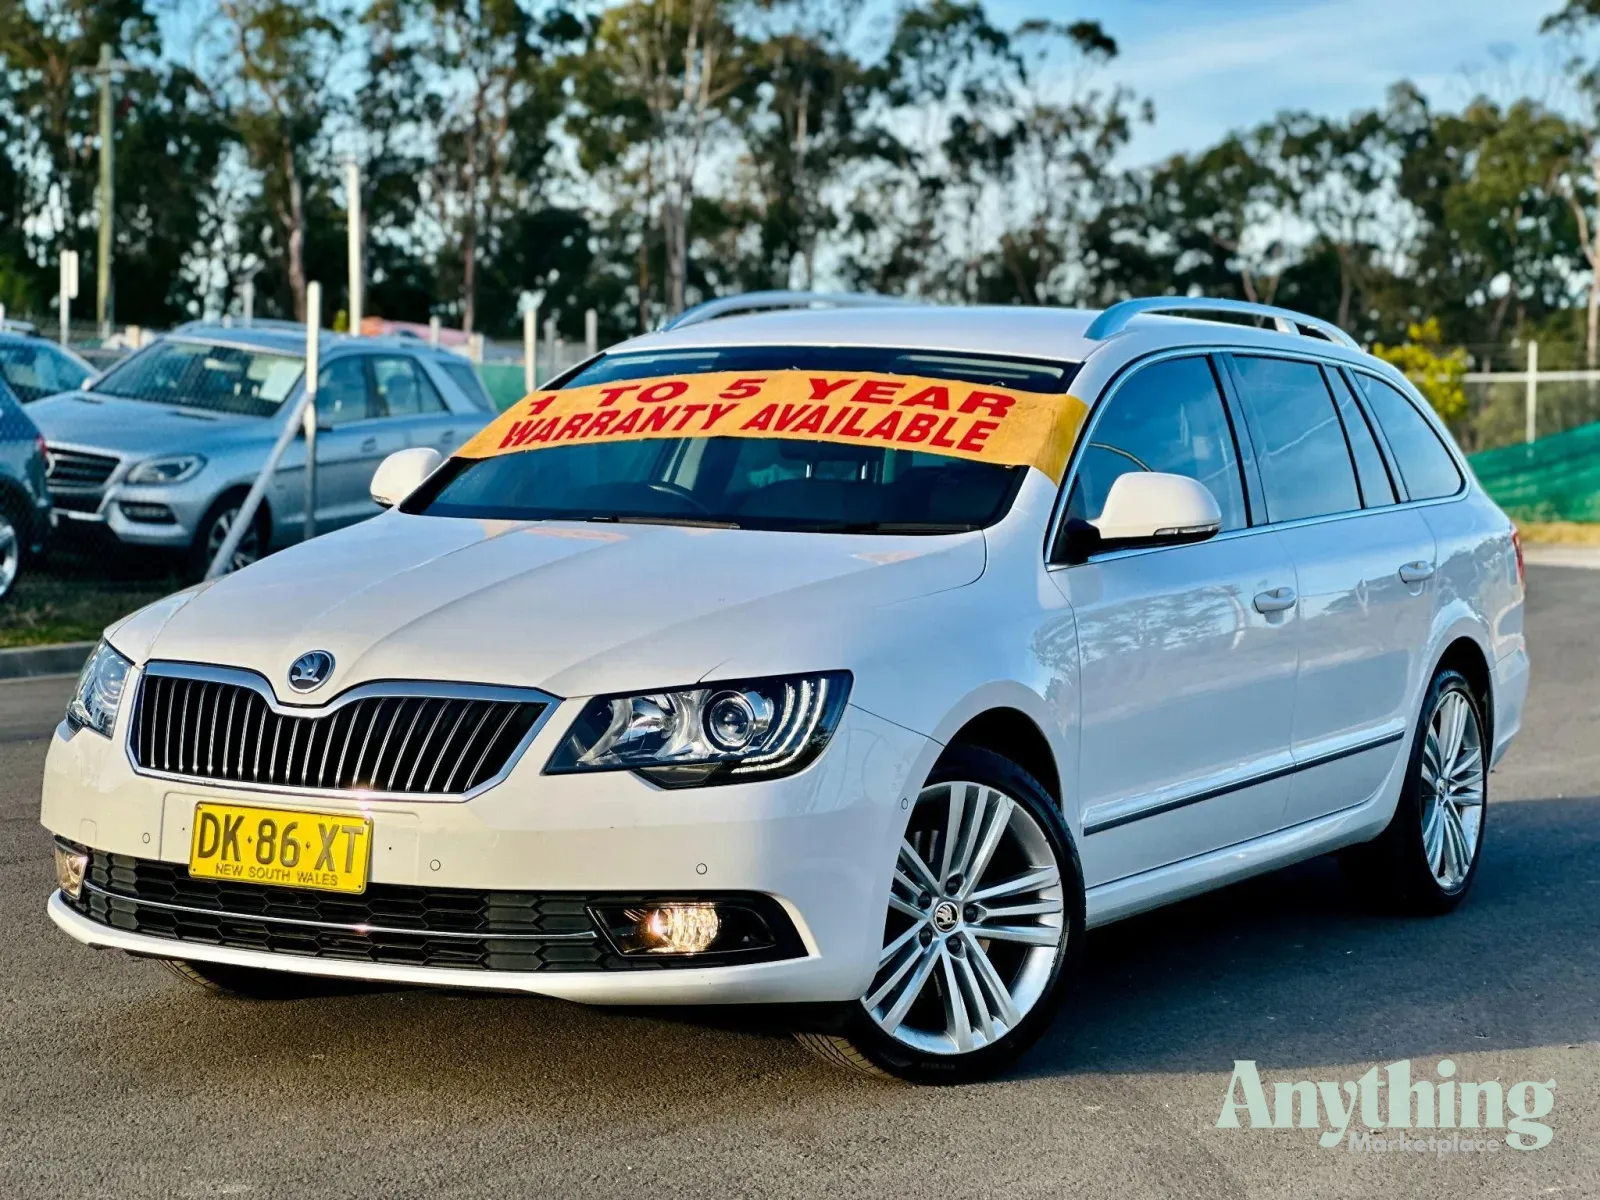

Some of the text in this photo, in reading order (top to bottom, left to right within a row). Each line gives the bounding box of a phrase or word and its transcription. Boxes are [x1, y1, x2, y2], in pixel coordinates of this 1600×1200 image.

[528, 378, 1017, 418] 1 TO 5 YEAR
[498, 402, 1001, 453] WARRANTY AVAILABLE
[215, 862, 338, 886] NEW SOUTH WALES
